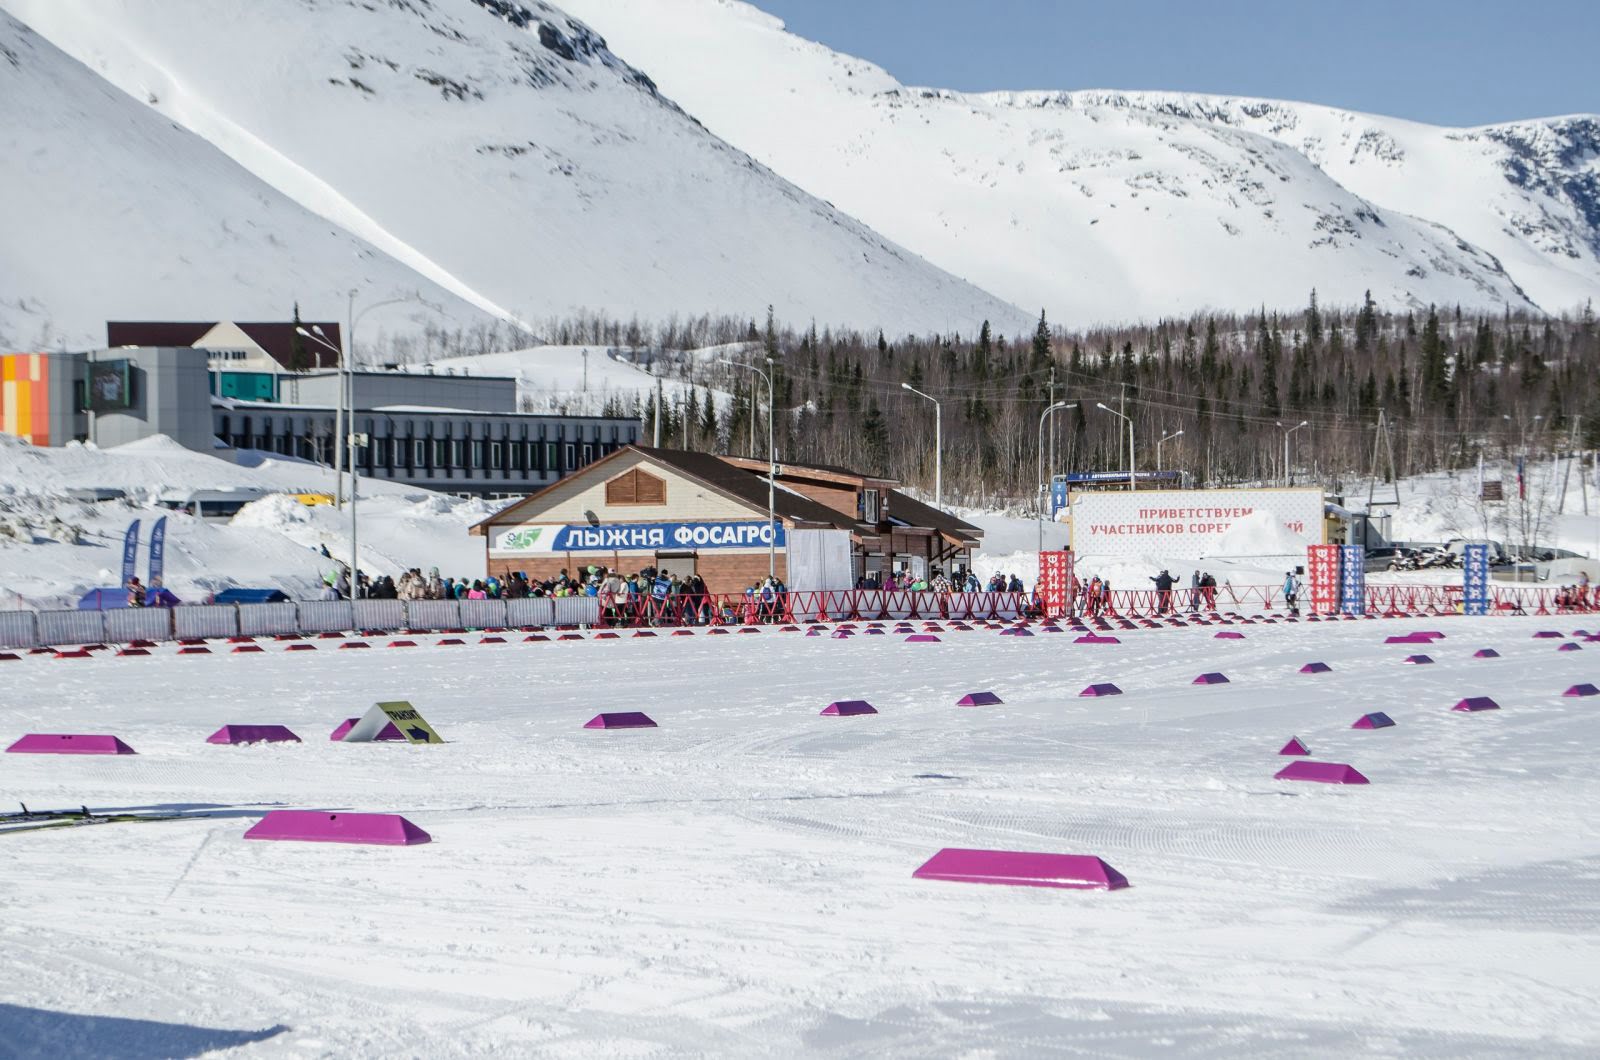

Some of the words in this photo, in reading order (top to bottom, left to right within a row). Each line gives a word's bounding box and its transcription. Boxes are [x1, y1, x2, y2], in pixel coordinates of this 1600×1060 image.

[565, 528, 664, 547] ЛЫЖНЯ
[674, 524, 777, 545] ФОСАГРО
[1090, 524, 1184, 535] УЧАСТНИКОВ
[1139, 508, 1253, 519] ПРИВЕТСТВУЕМ
[1047, 555, 1060, 616] ФИНИШ
[1316, 549, 1329, 612] ФИНИШ
[1344, 548, 1356, 612] СТАРТ
[1471, 548, 1481, 612] СТАРТ
